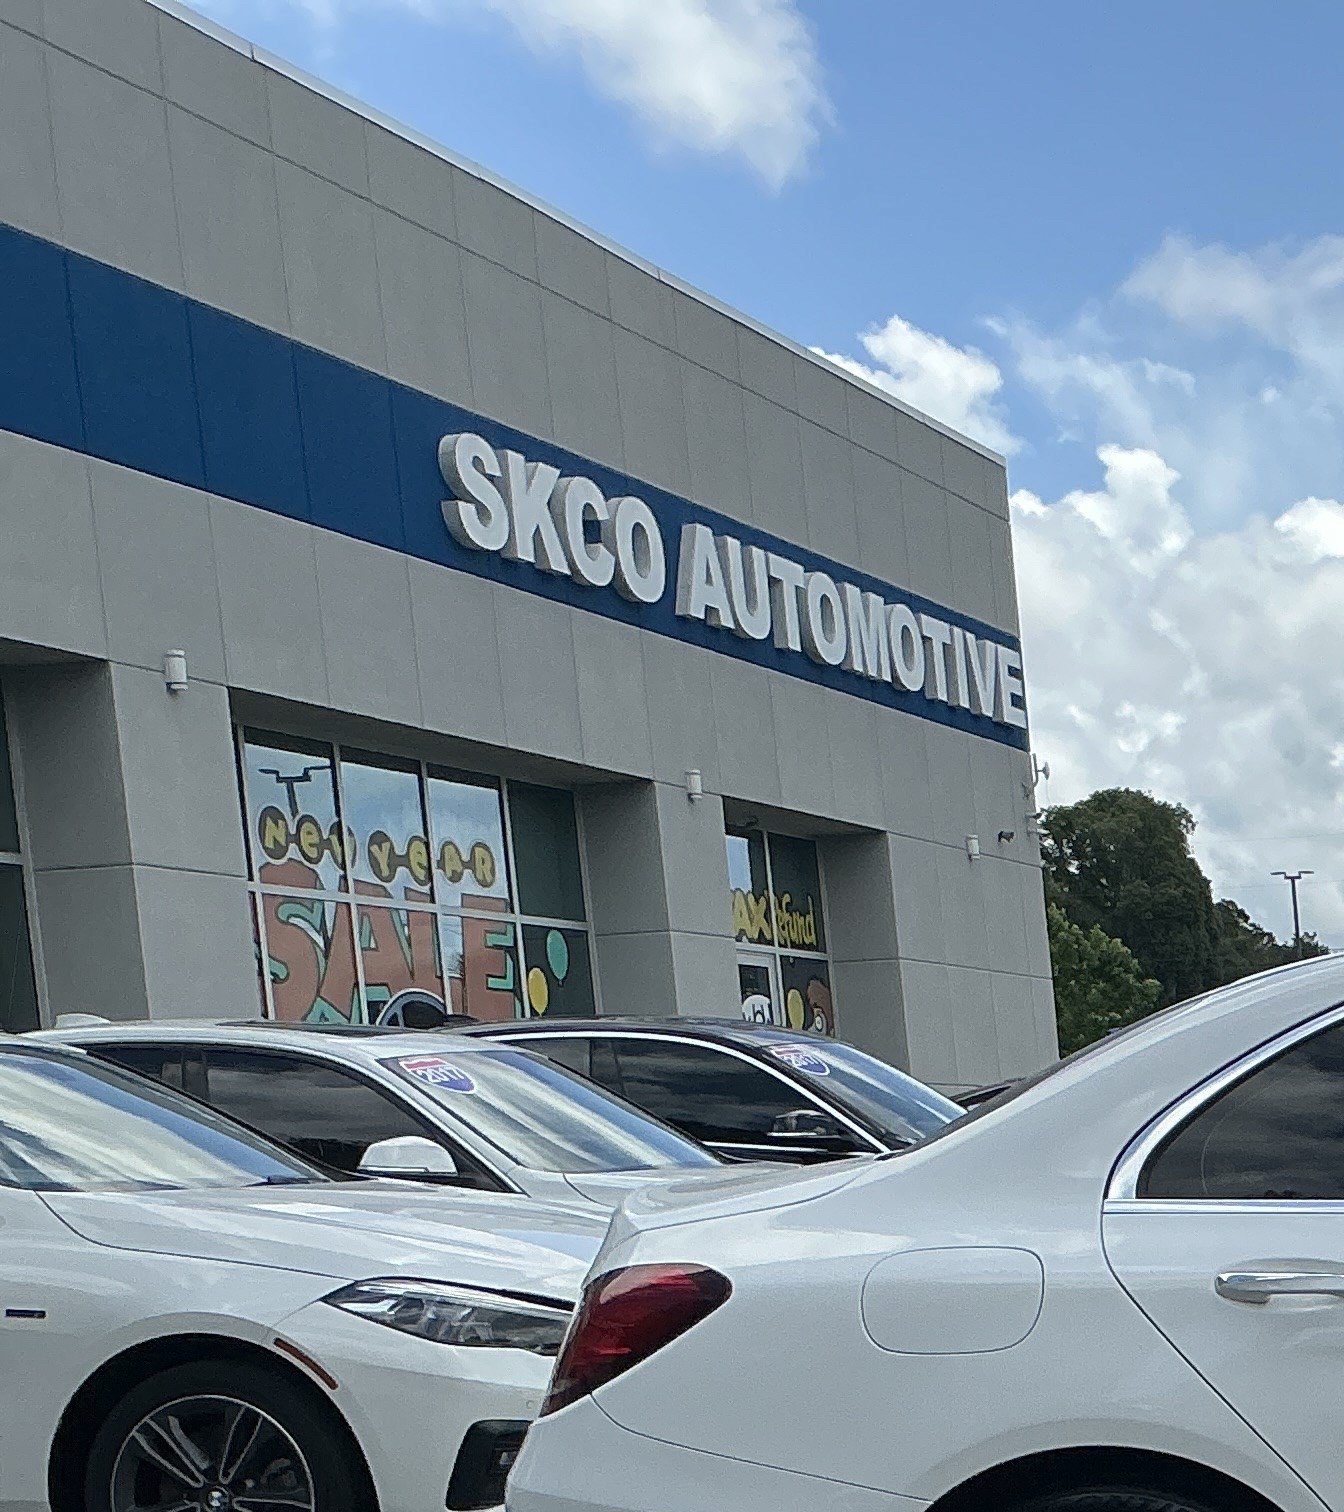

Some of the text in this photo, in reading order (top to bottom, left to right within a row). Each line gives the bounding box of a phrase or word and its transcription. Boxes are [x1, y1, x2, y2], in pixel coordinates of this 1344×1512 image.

[439, 432, 1028, 730] SKCO AUTOMOTIVE
[415, 1065, 465, 1083] 2017
